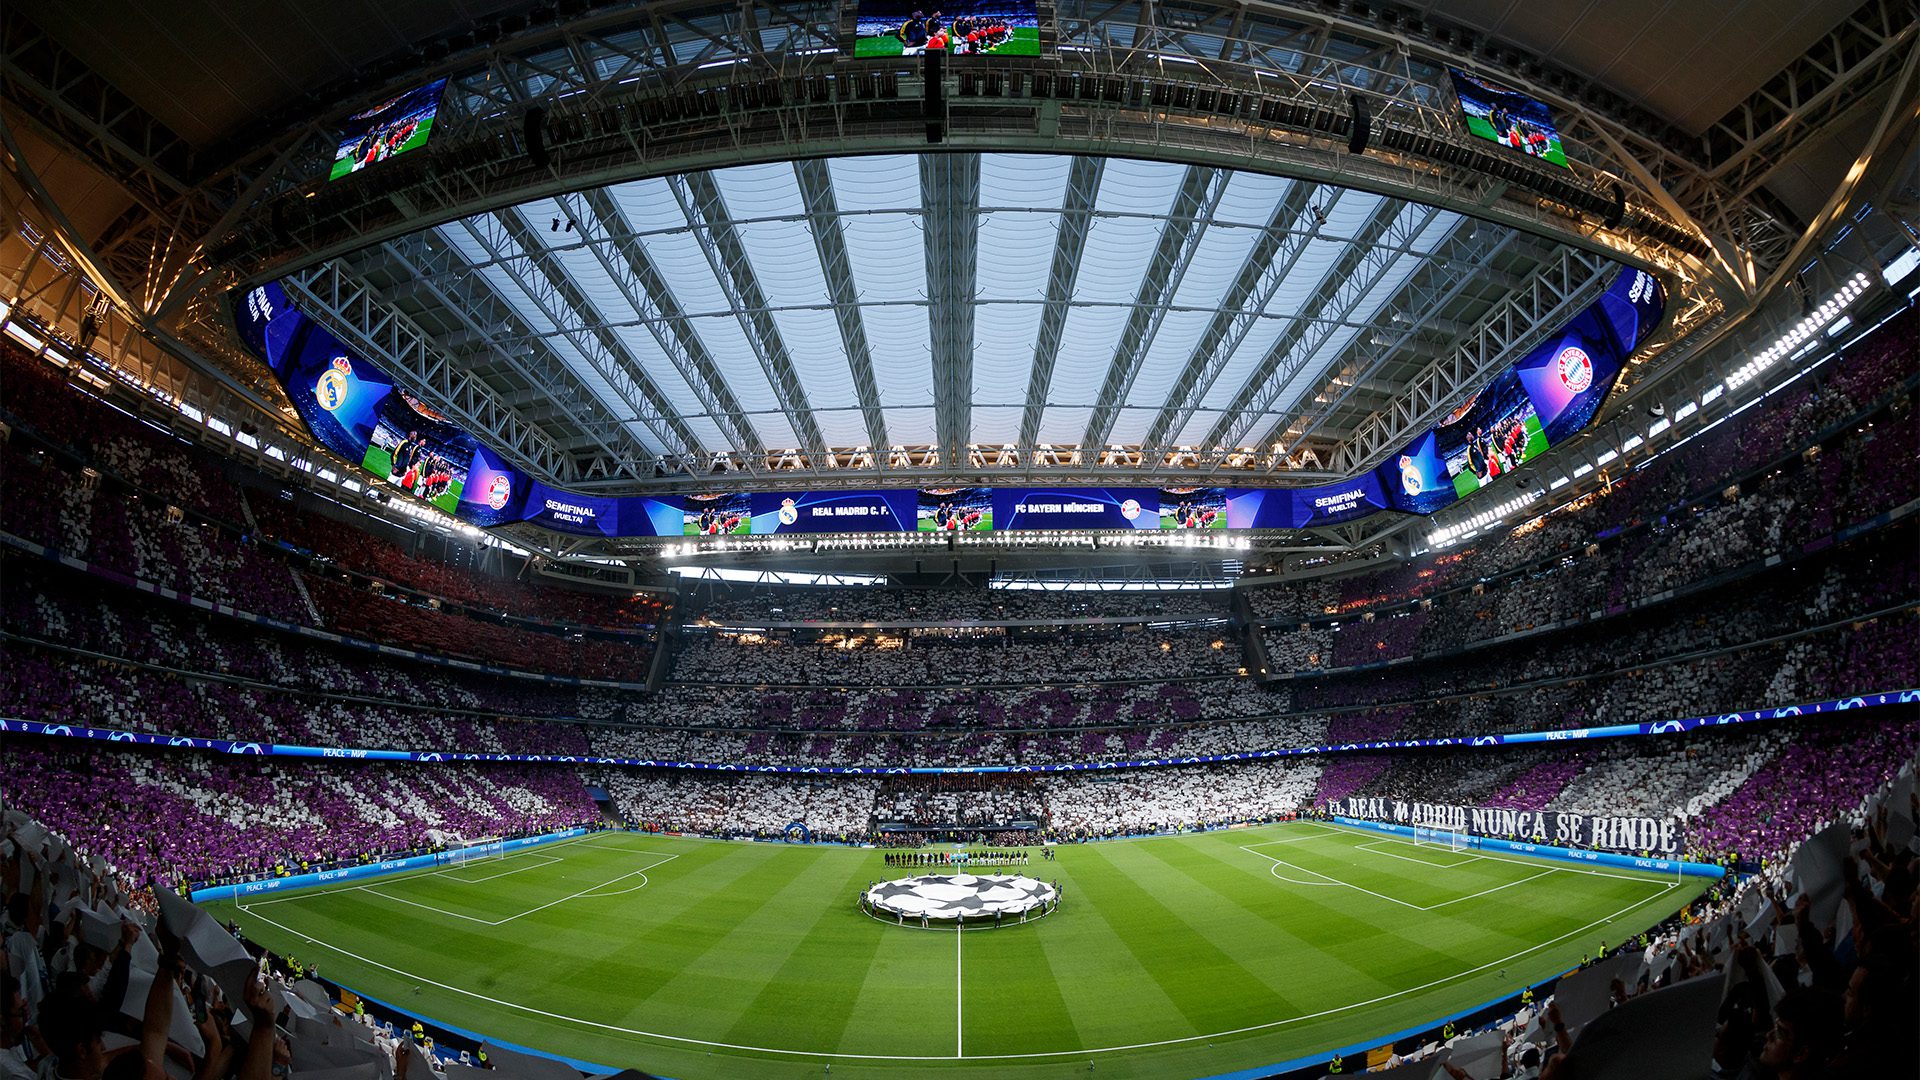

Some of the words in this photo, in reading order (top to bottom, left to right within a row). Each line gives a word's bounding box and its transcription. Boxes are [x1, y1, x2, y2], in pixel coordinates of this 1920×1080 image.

[1315, 488, 1366, 507] SEMIFINAL
[545, 499, 596, 517] SEMIFINAL
[812, 507, 834, 516] REAL
[835, 507, 869, 516] MADRID
[870, 507, 879, 515] C.
[881, 506, 889, 515] F.
[1015, 504, 1027, 513] FC
[1028, 504, 1062, 513] BAYERN
[1063, 502, 1105, 513] MÜNCHEN
[1328, 500, 1357, 514] (VUELTA)
[553, 512, 583, 524] (VUELTA)
[1546, 731, 1568, 740] PEACE
[323, 748, 345, 757] PEACE
[1328, 800, 1345, 816] EL
[1348, 797, 1388, 819] REAL
[1393, 801, 1466, 831] MADRID
[1472, 808, 1548, 840] NUNCA
[1556, 813, 1584, 843] SE
[1592, 816, 1677, 852] RINDE
